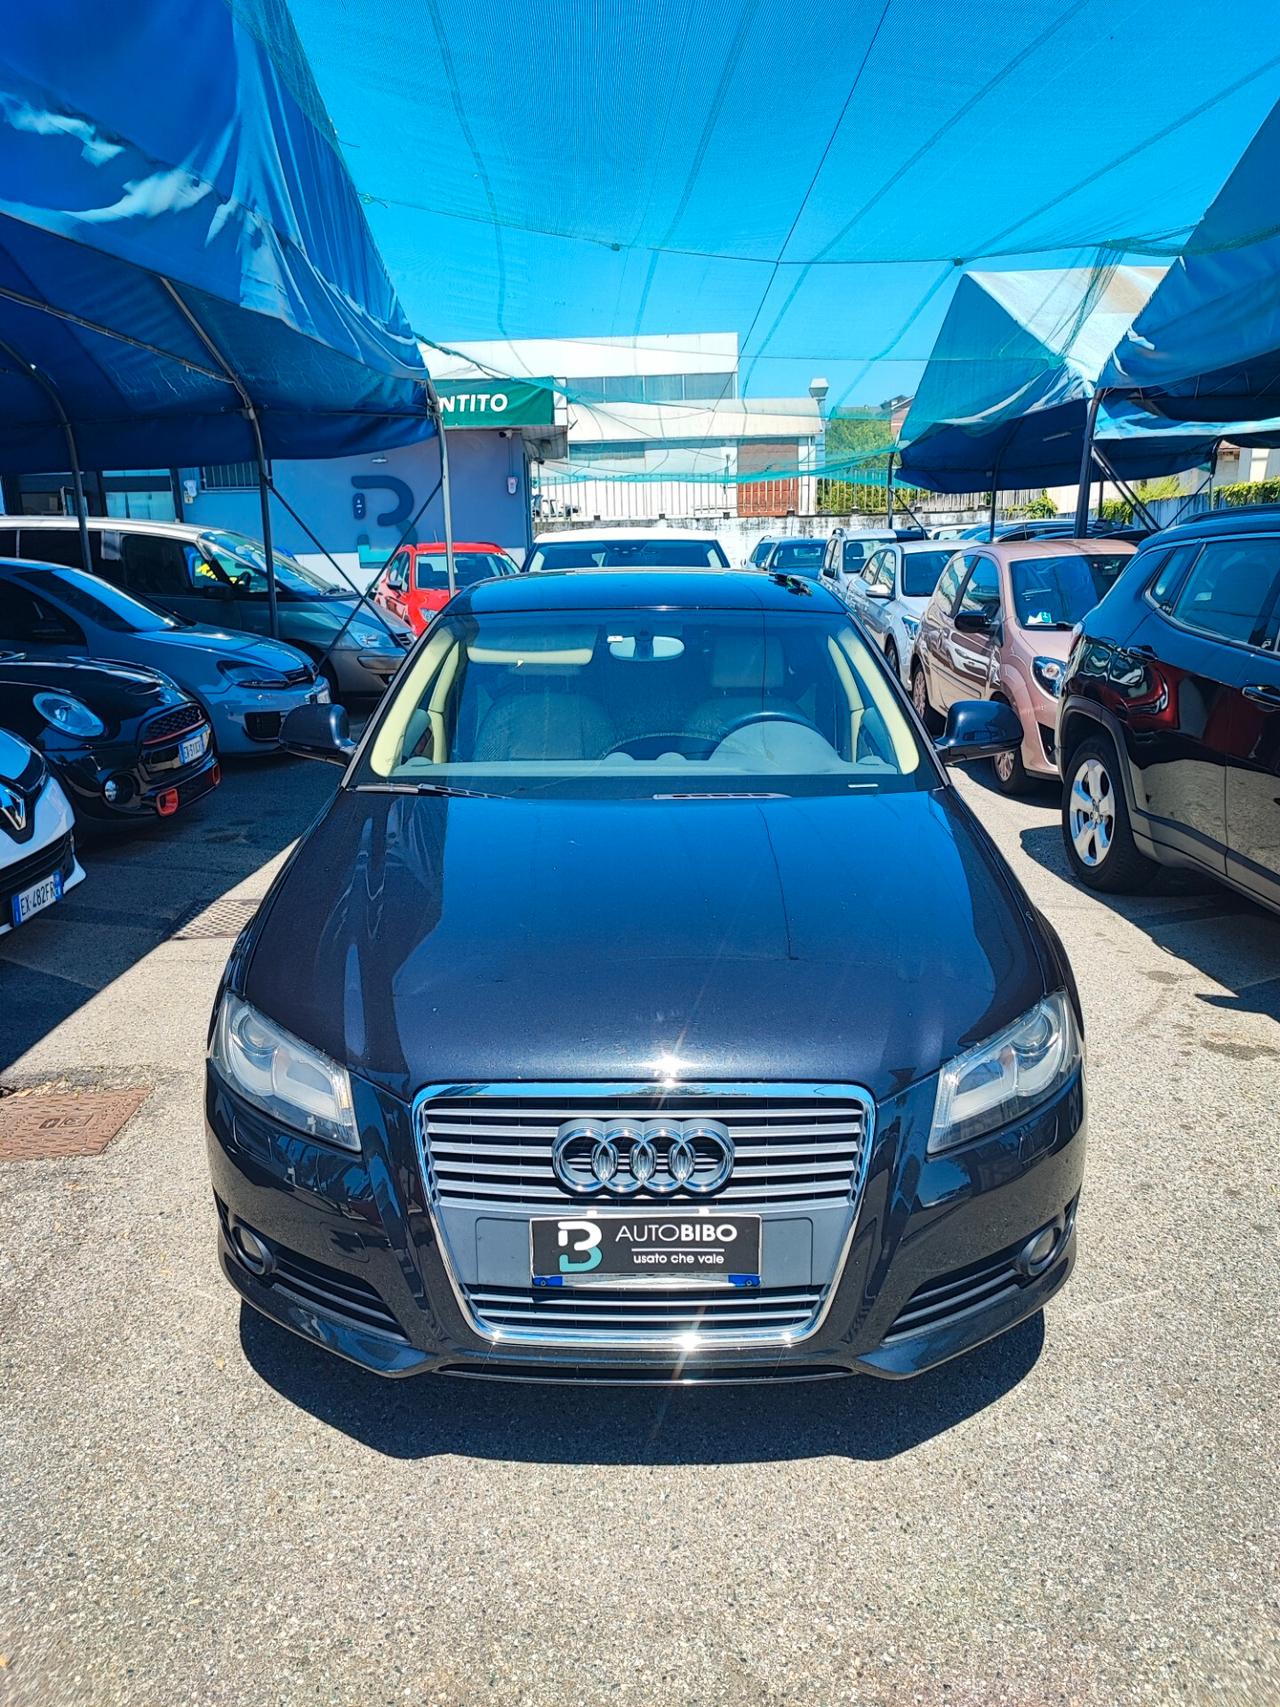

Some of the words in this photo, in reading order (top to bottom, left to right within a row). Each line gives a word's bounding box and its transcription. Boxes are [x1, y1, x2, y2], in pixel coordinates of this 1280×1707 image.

[615, 1224, 738, 1242] AUTOBIBO
[633, 1253, 668, 1264] usato
[670, 1253, 695, 1264] che
[697, 1254, 725, 1264] vale
